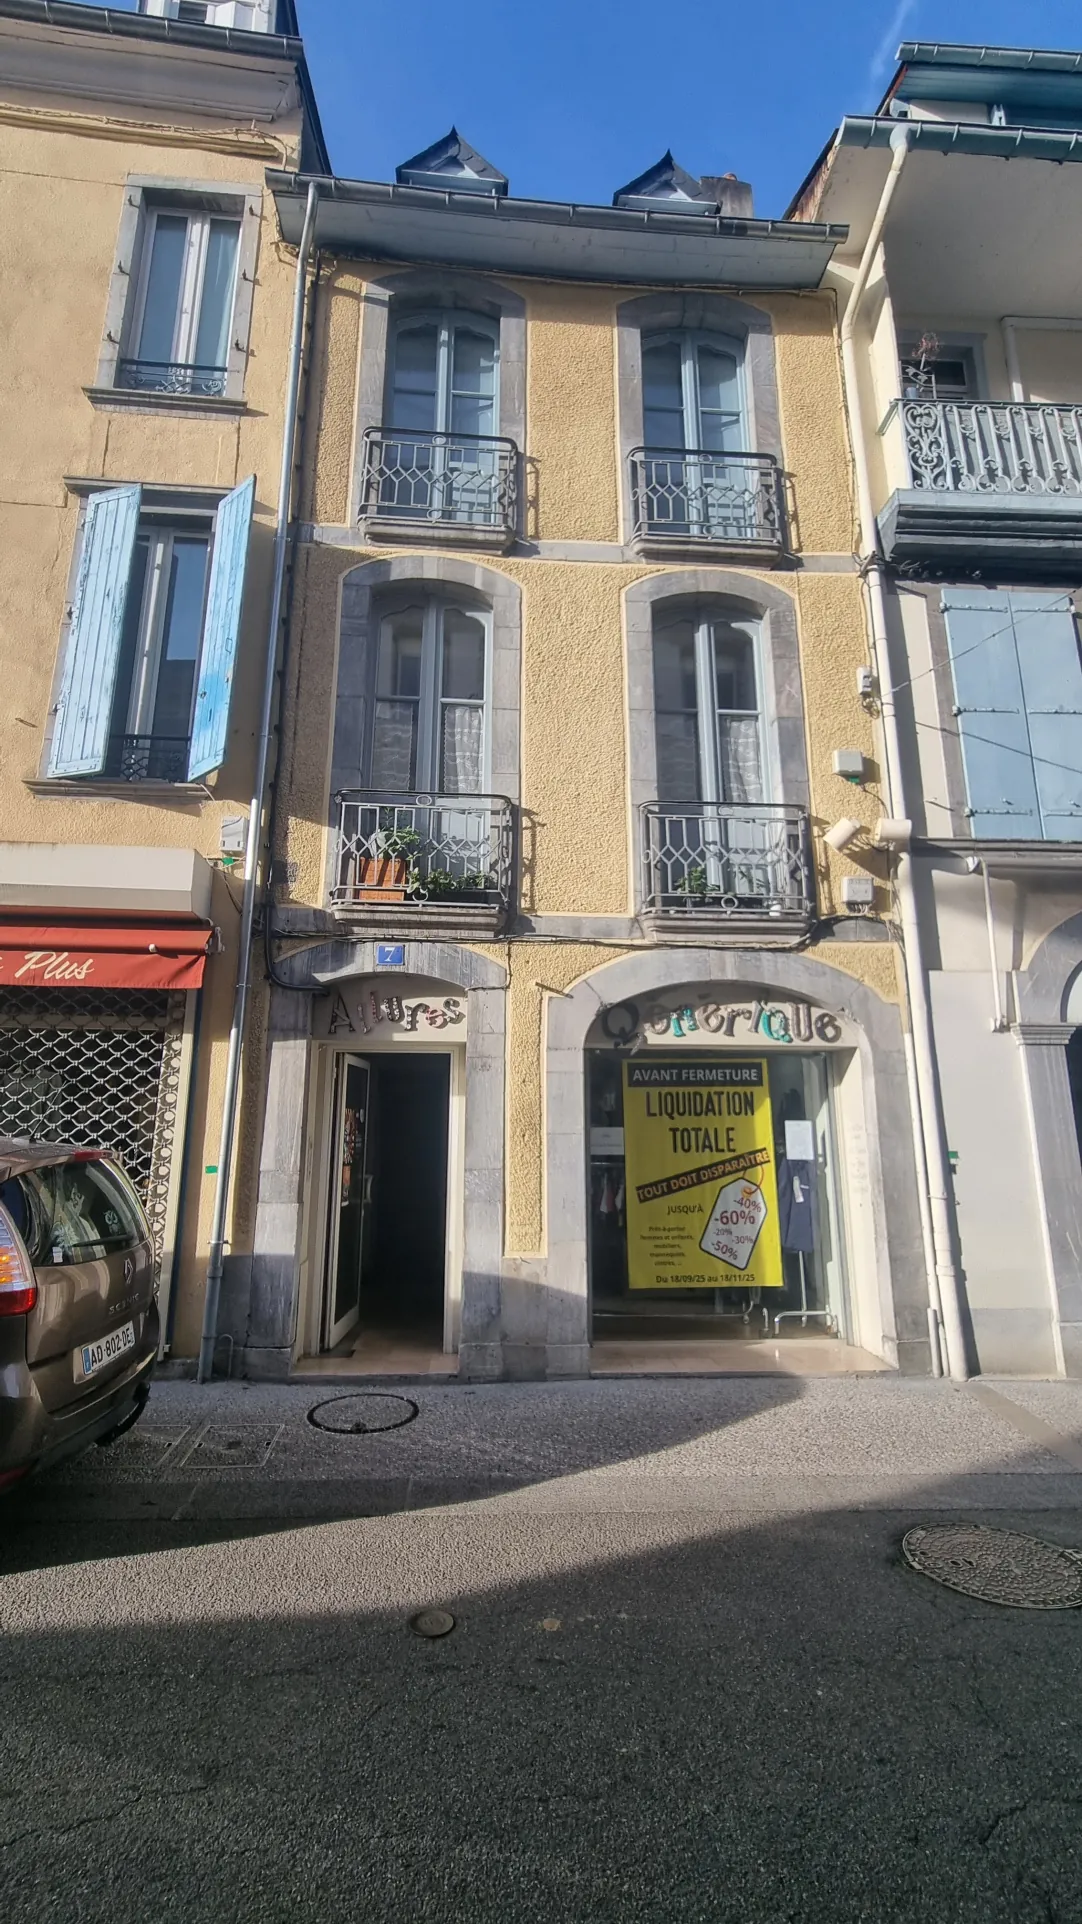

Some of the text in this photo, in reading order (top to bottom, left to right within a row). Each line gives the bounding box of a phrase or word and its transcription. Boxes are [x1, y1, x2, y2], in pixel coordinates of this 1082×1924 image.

[384, 946, 396, 962] 7
[14, 951, 95, 980] Plus
[632, 1069, 759, 1081] AVANT FERMETURE
[645, 1091, 755, 1120] LIQUIDATION
[669, 1127, 737, 1153] TOTALE
[638, 1150, 770, 1200] TOUT DOIT DISPARAÎTRE
[733, 1197, 762, 1213] -40%
[714, 1210, 756, 1226] -60%
[711, 1240, 738, 1260] -50%
[655, 1275, 668, 1283] Du
[670, 1274, 705, 1283] 18/09/25
[720, 1273, 755, 1282] 18/11/25
